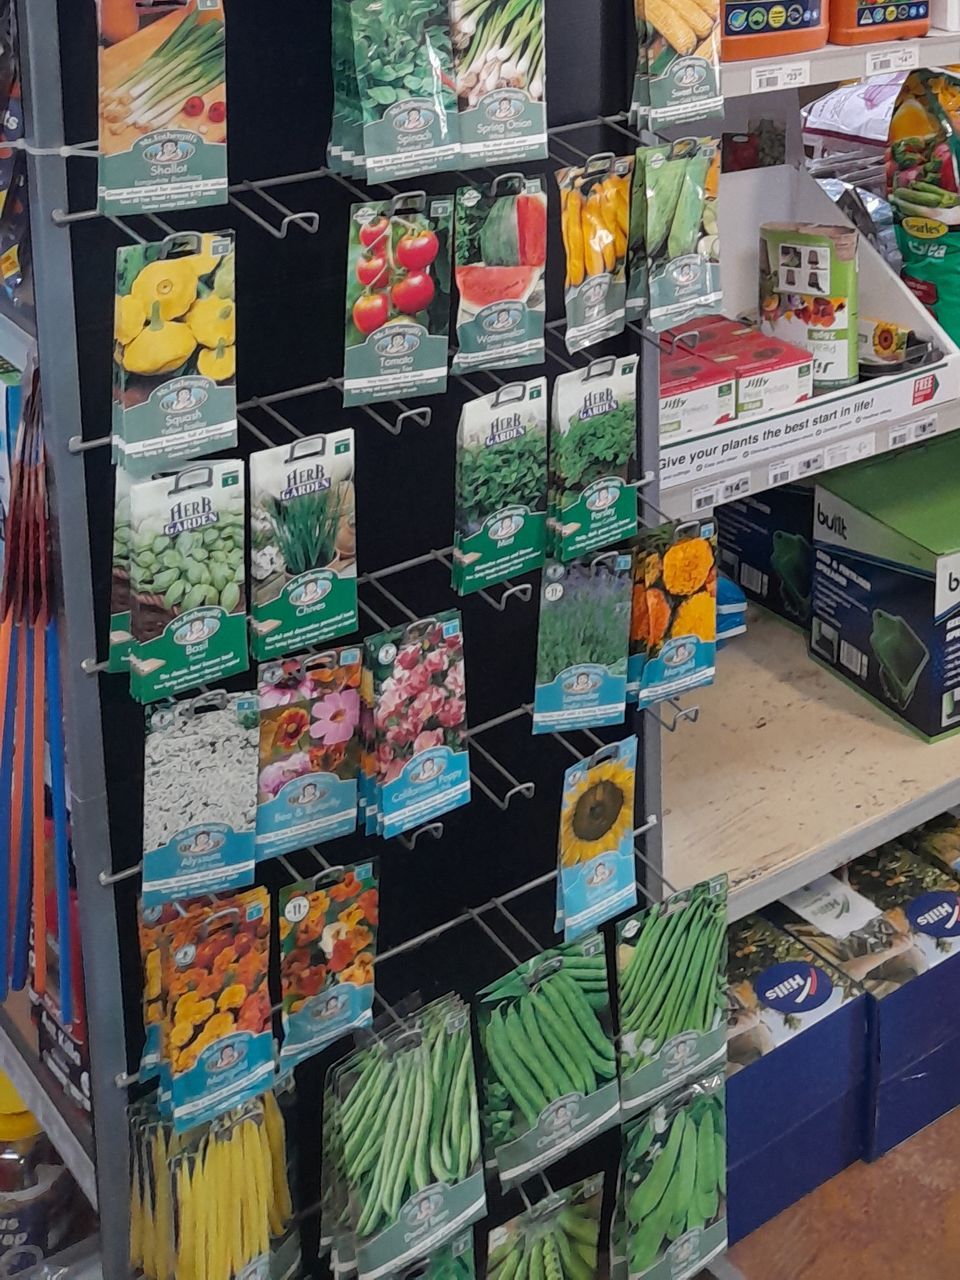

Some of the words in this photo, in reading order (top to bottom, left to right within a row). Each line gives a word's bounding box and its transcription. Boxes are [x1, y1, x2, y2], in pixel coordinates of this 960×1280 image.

[477, 121, 504, 135] Spring
[150, 164, 188, 177] Shallot
[380, 355, 414, 366] Tomato
[745, 376, 770, 389] Jiffy
[914, 376, 934, 391] FREE
[583, 387, 613, 406] HERB
[662, 397, 688, 410] Jiffy
[579, 400, 618, 420] GARDEN
[491, 413, 521, 433] HERB
[485, 425, 526, 447] GARDEN
[659, 456, 686, 471] Give
[689, 444, 720, 466] your
[721, 433, 759, 455] plants
[763, 425, 782, 441] the
[784, 419, 811, 436] best
[812, 410, 838, 428] start
[840, 405, 852, 419] in
[853, 397, 875, 414] life!
[287, 464, 326, 488] HERB
[280, 478, 331, 502] GARDEN
[170, 495, 212, 522] HERB
[164, 511, 219, 536] GARDEN
[817, 503, 847, 540] built
[296, 602, 326, 616] Chives
[186, 641, 209, 655] Basil
[916, 900, 953, 927] Hills
[765, 973, 805, 1002] Hills
